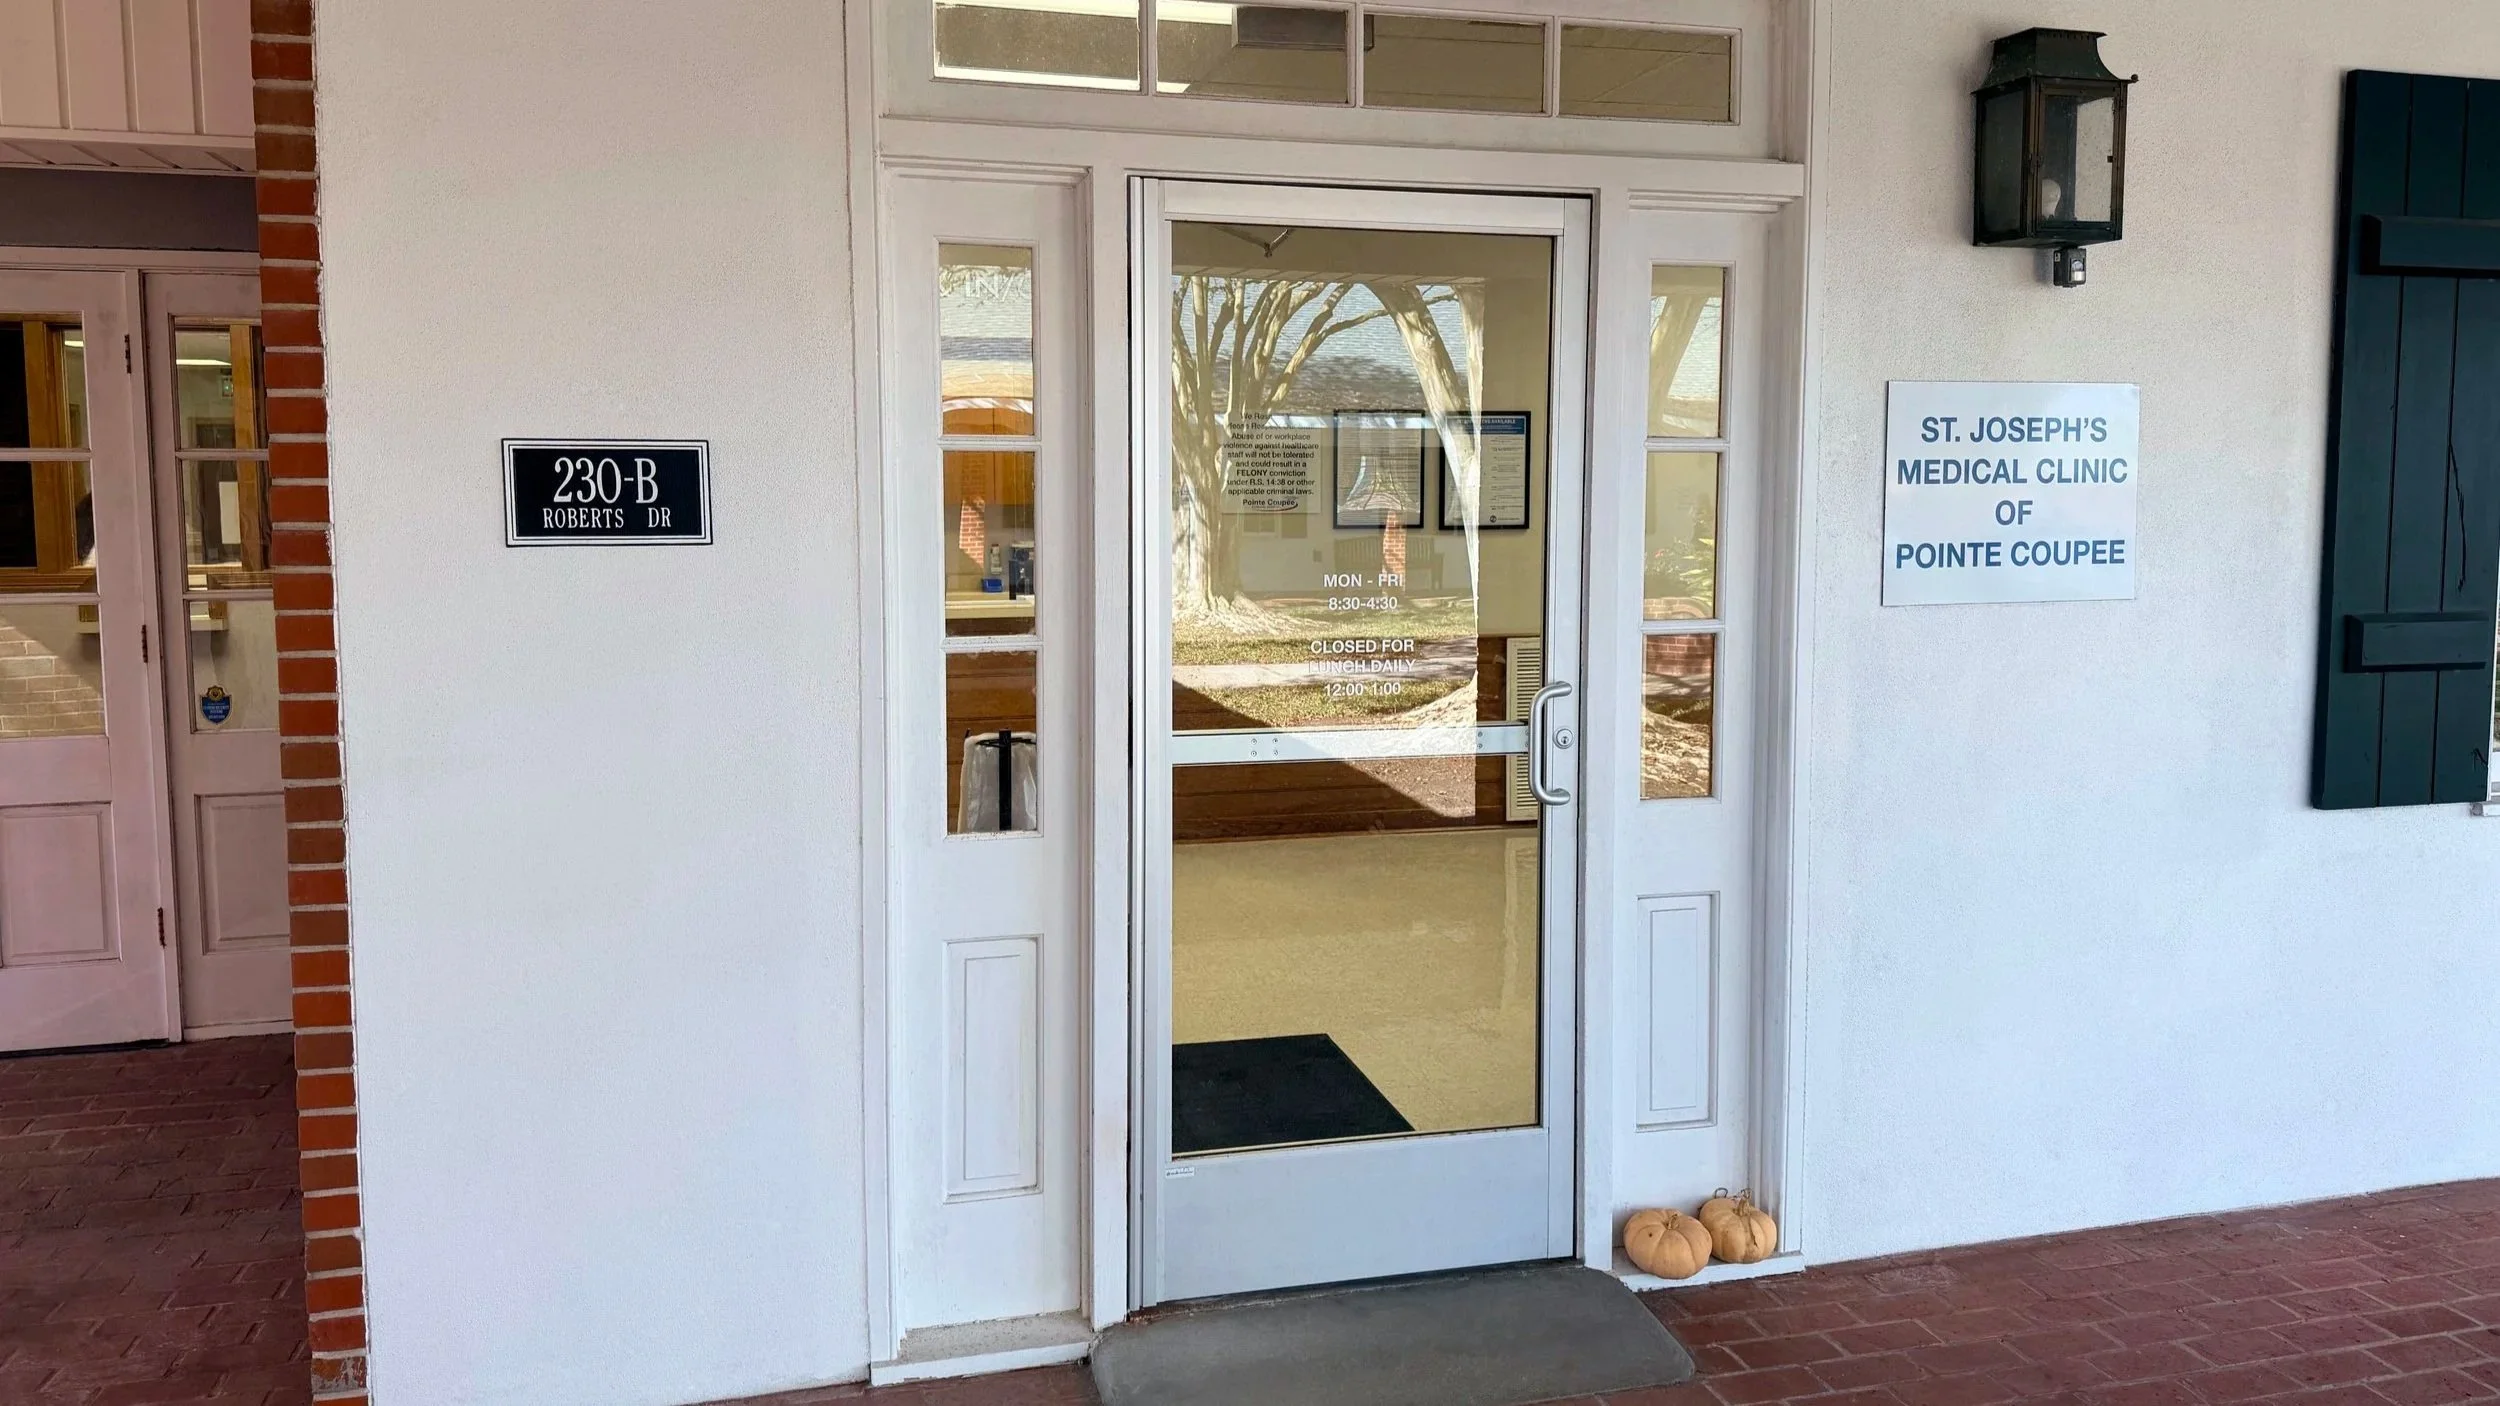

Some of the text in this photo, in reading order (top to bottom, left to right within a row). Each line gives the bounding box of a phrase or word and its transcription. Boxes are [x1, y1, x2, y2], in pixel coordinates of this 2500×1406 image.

[1274, 433, 1311, 441] workplace
[1921, 416, 2108, 443] ST. JOSEPH'S
[1254, 442, 1281, 451] against
[1281, 442, 1319, 450] healthcare
[1236, 469, 1306, 477] FELONY conviction
[1897, 457, 2128, 485] MEDICAL CLINIC
[553, 456, 659, 505] 230-B
[1228, 488, 1265, 496] applicable
[542, 507, 672, 529] ROBERTS DR
[1994, 500, 2033, 526] OF
[1896, 539, 2126, 569] POINTE COUPEE
[1323, 573, 1362, 588] MON
[1378, 573, 1403, 587] FRI
[1328, 596, 1398, 611] 8:30-4:30
[1310, 638, 1415, 654] CLOSED FOR
[1309, 658, 1416, 674] LUNCH DAILY
